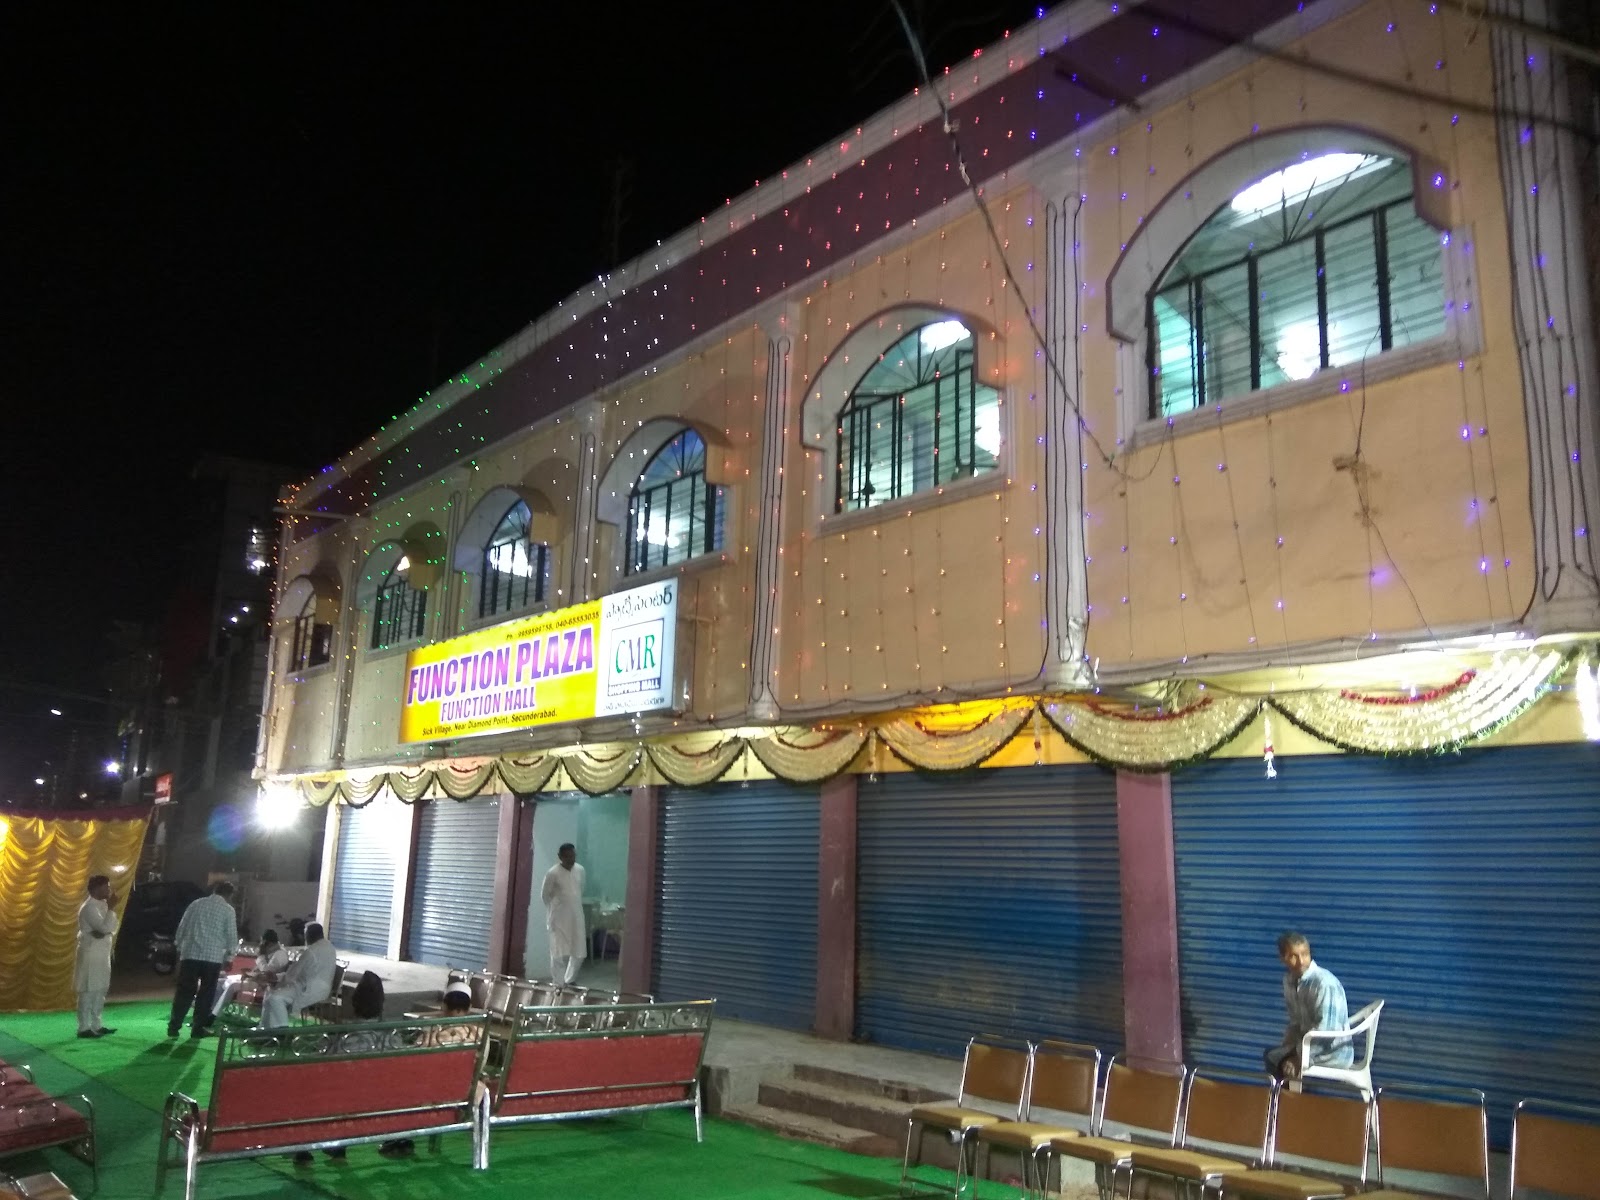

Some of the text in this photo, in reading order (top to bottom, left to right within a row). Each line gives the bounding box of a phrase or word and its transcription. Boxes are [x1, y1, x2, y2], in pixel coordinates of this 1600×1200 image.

[407, 627, 593, 704] FUNCTION PLAZA
[615, 634, 656, 674] CMR
[441, 687, 535, 722] FUNCTION HALL
[468, 720, 491, 729] Diamond
[511, 708, 558, 722] Secunderabad.
